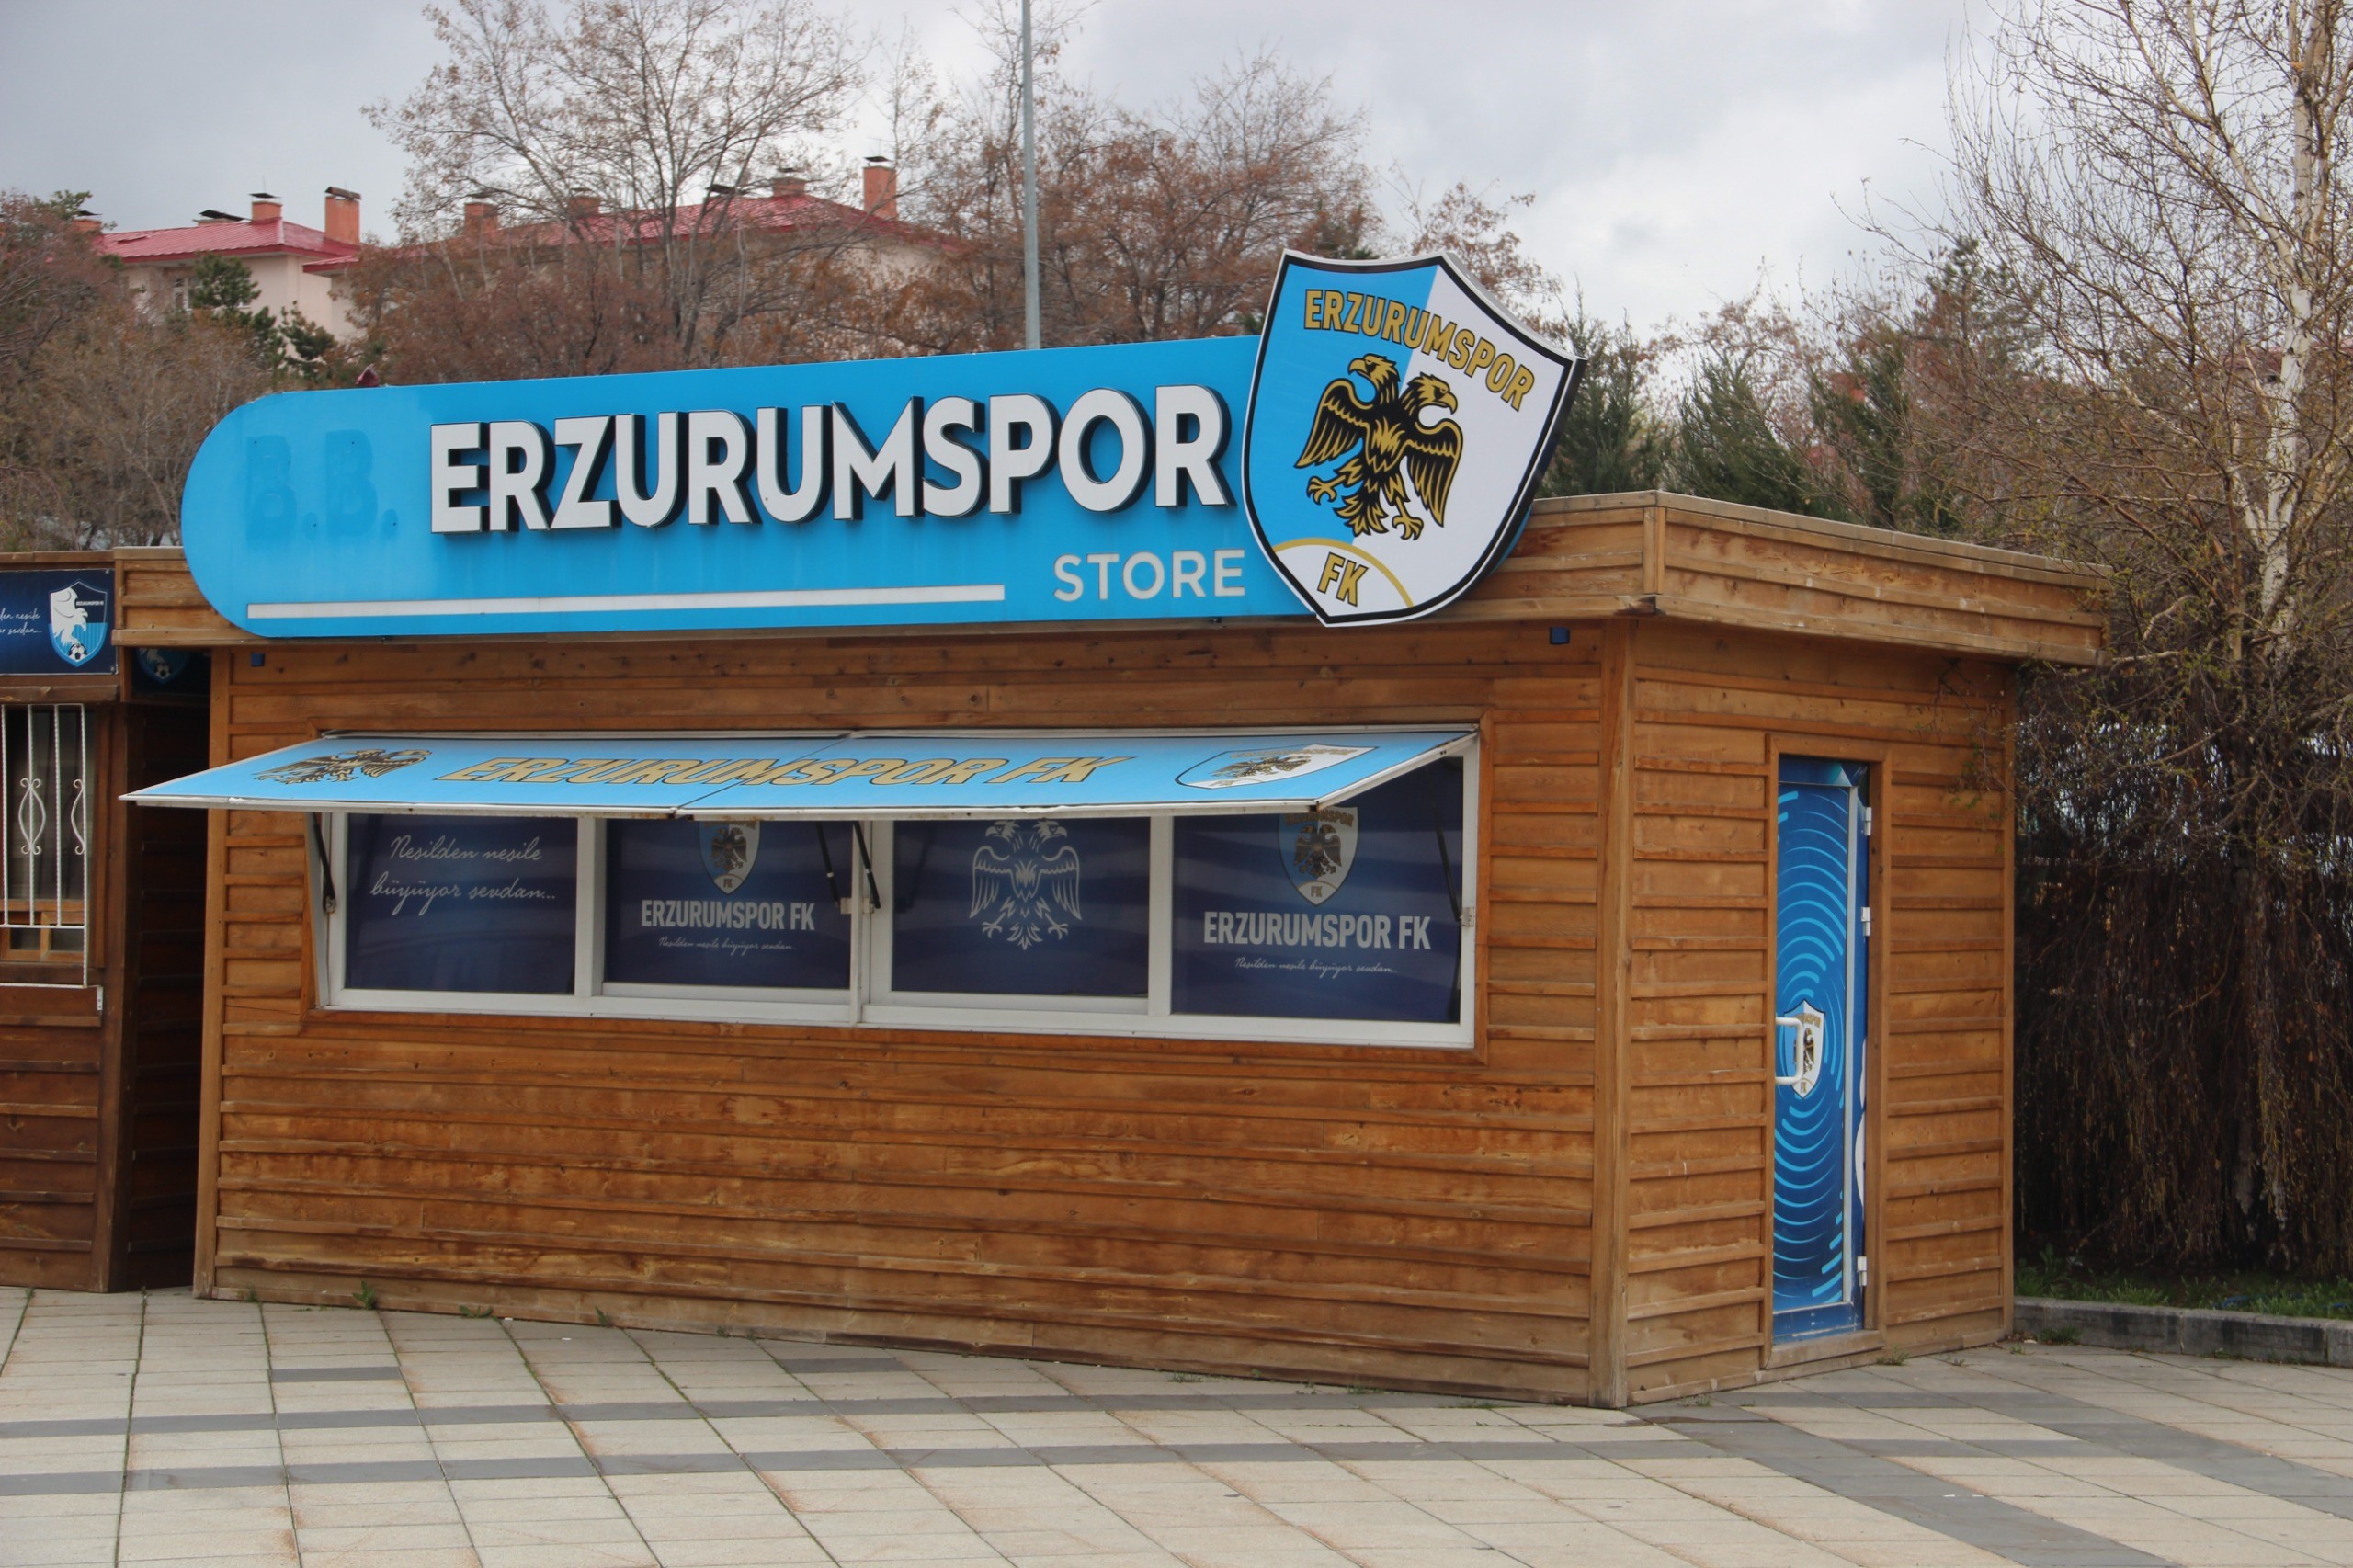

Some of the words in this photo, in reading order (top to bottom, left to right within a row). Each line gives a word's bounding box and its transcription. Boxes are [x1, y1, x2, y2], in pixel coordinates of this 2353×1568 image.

[1303, 288, 1536, 413] ERZURUMSPOR
[430, 383, 1238, 534] ERZURUMSPOR
[1054, 549, 1246, 603] STORE
[1317, 551, 1369, 608] FK
[433, 756, 1010, 786] ERZURUMSPOR
[983, 756, 1138, 784] FK
[390, 835, 479, 861] Nesilden
[482, 836, 542, 862] nesile
[369, 871, 461, 916] büyüyor
[642, 899, 785, 930] ERZURUMSPOR
[790, 903, 816, 931] FK
[1203, 911, 1392, 949] ERZURUMSPOR
[1398, 915, 1432, 950] FK
[1234, 956, 1276, 970] Nesilden
[1279, 958, 1307, 971] nesile
